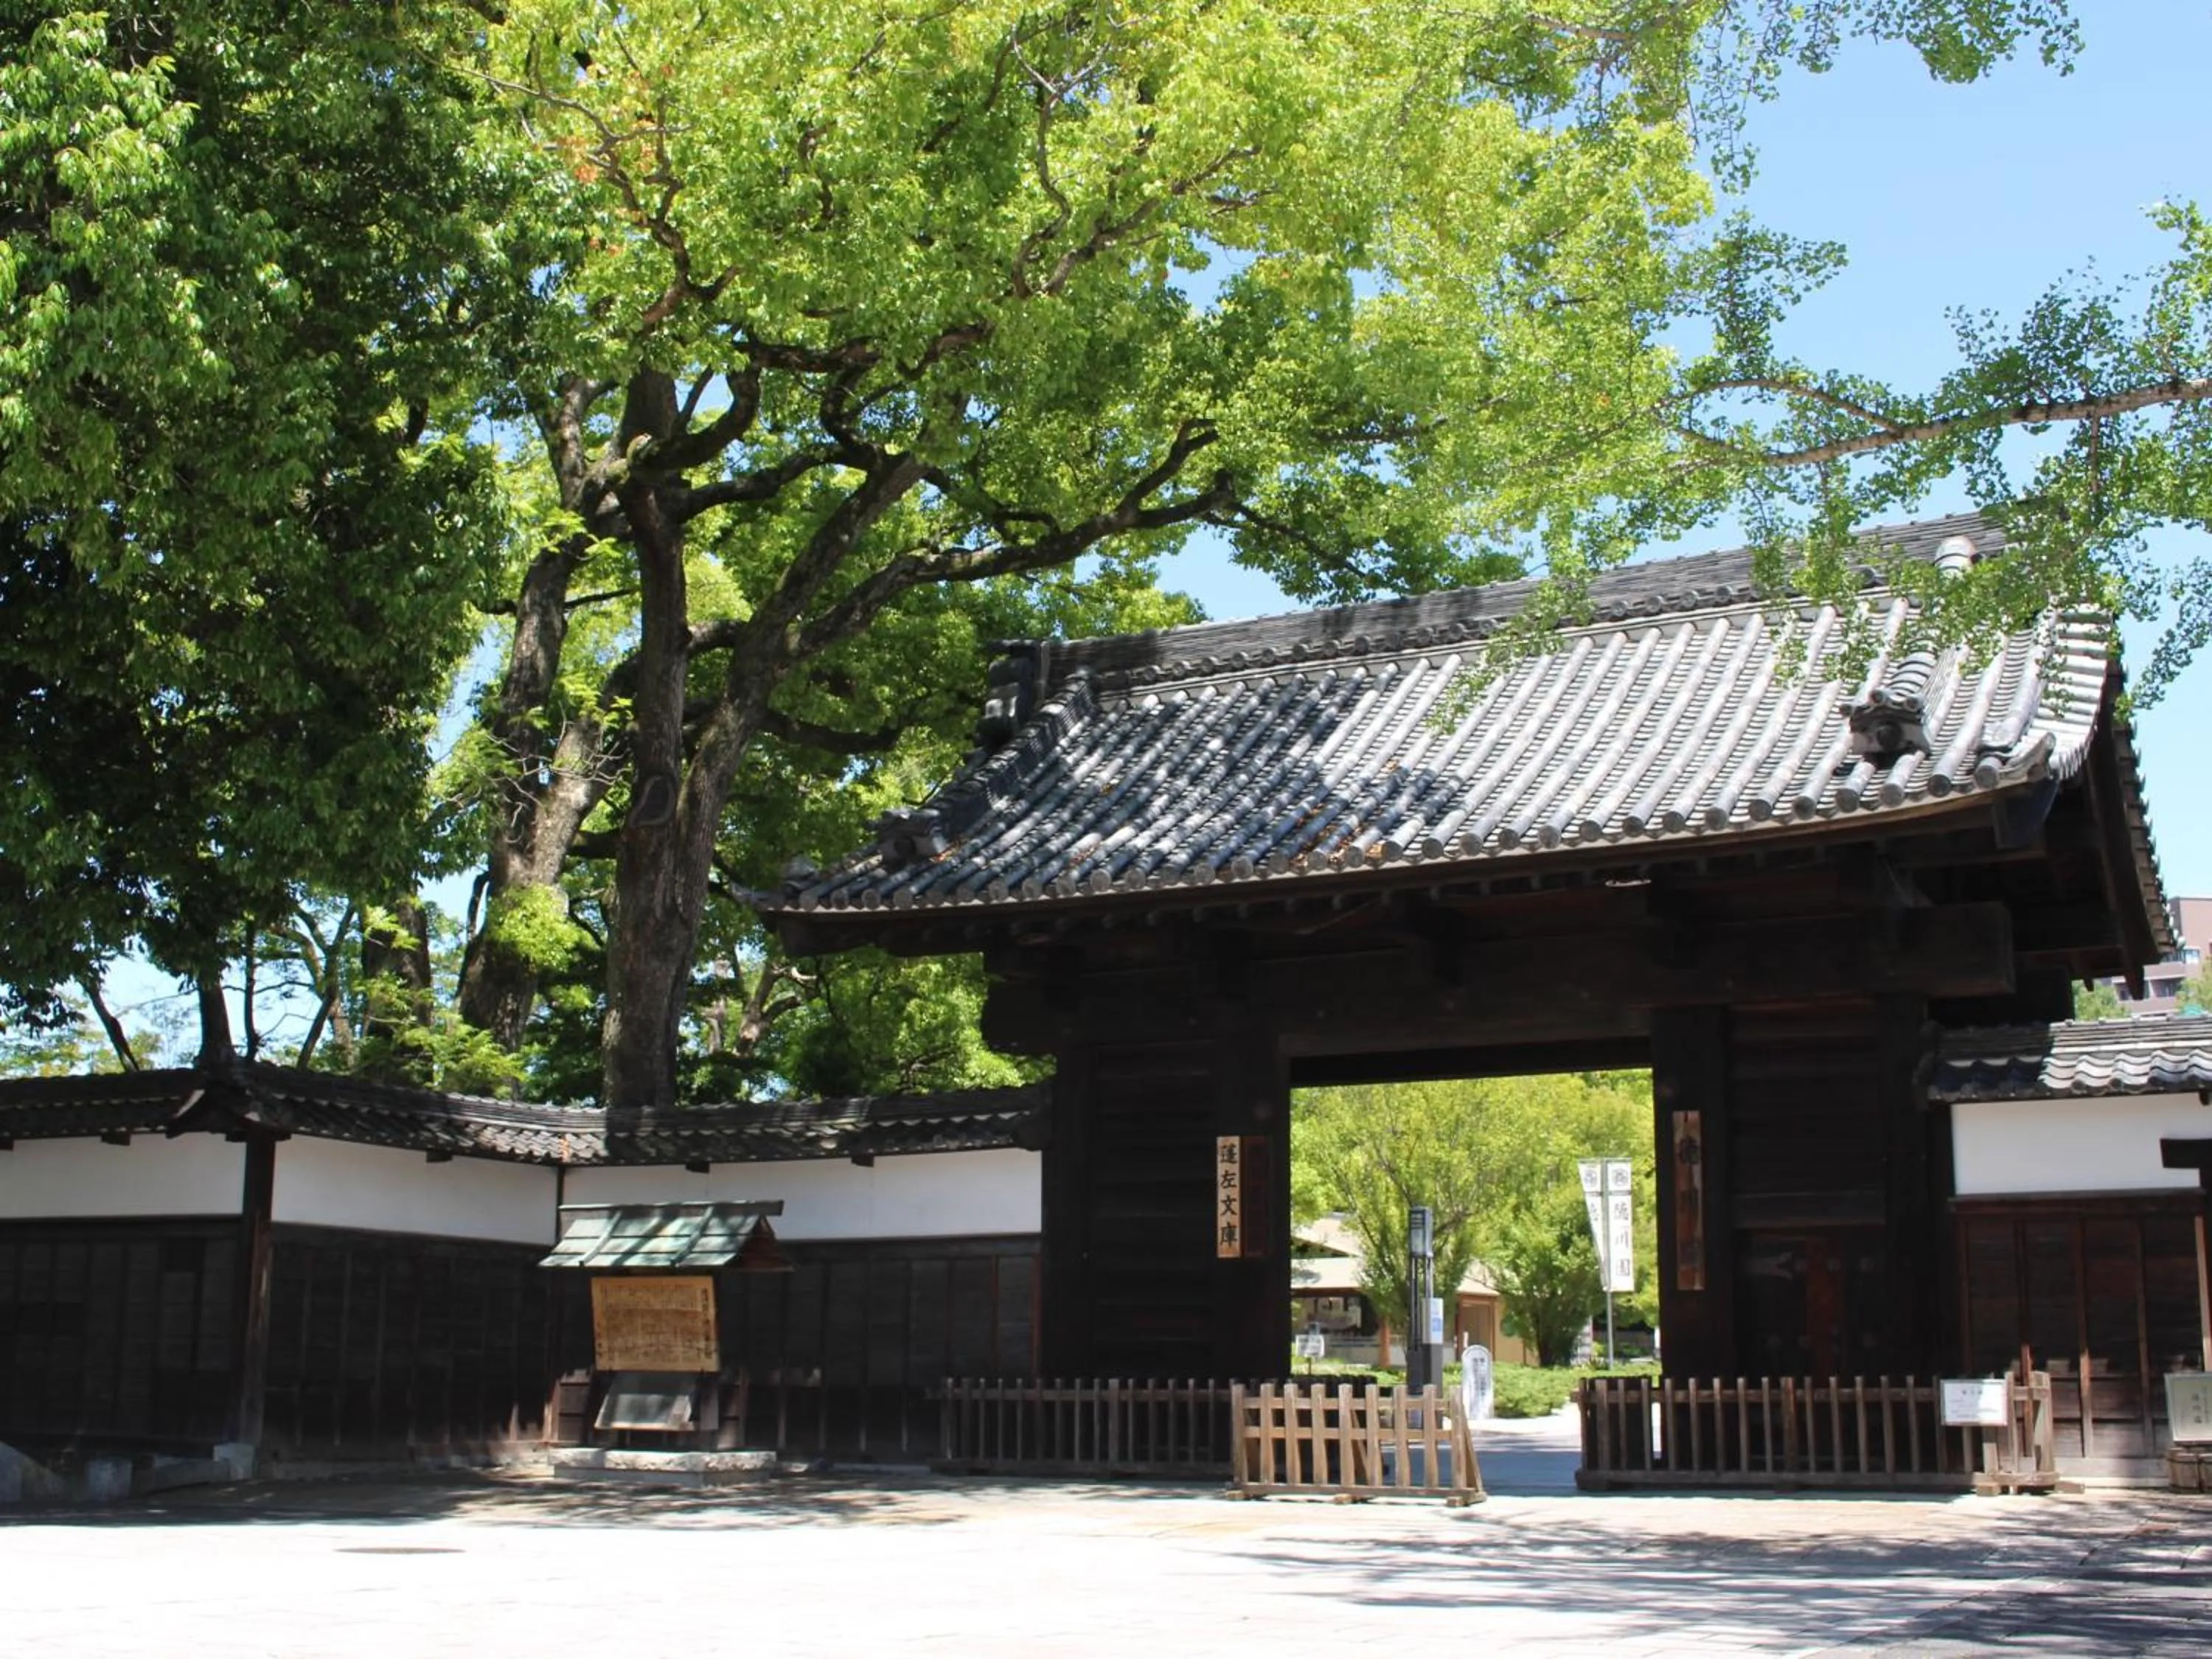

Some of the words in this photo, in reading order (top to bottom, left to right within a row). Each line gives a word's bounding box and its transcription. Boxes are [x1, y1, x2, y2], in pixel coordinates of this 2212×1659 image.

[1220, 1144, 1238, 1248] 蓬左文庫
[1613, 1200, 1631, 1277] 徳川園
